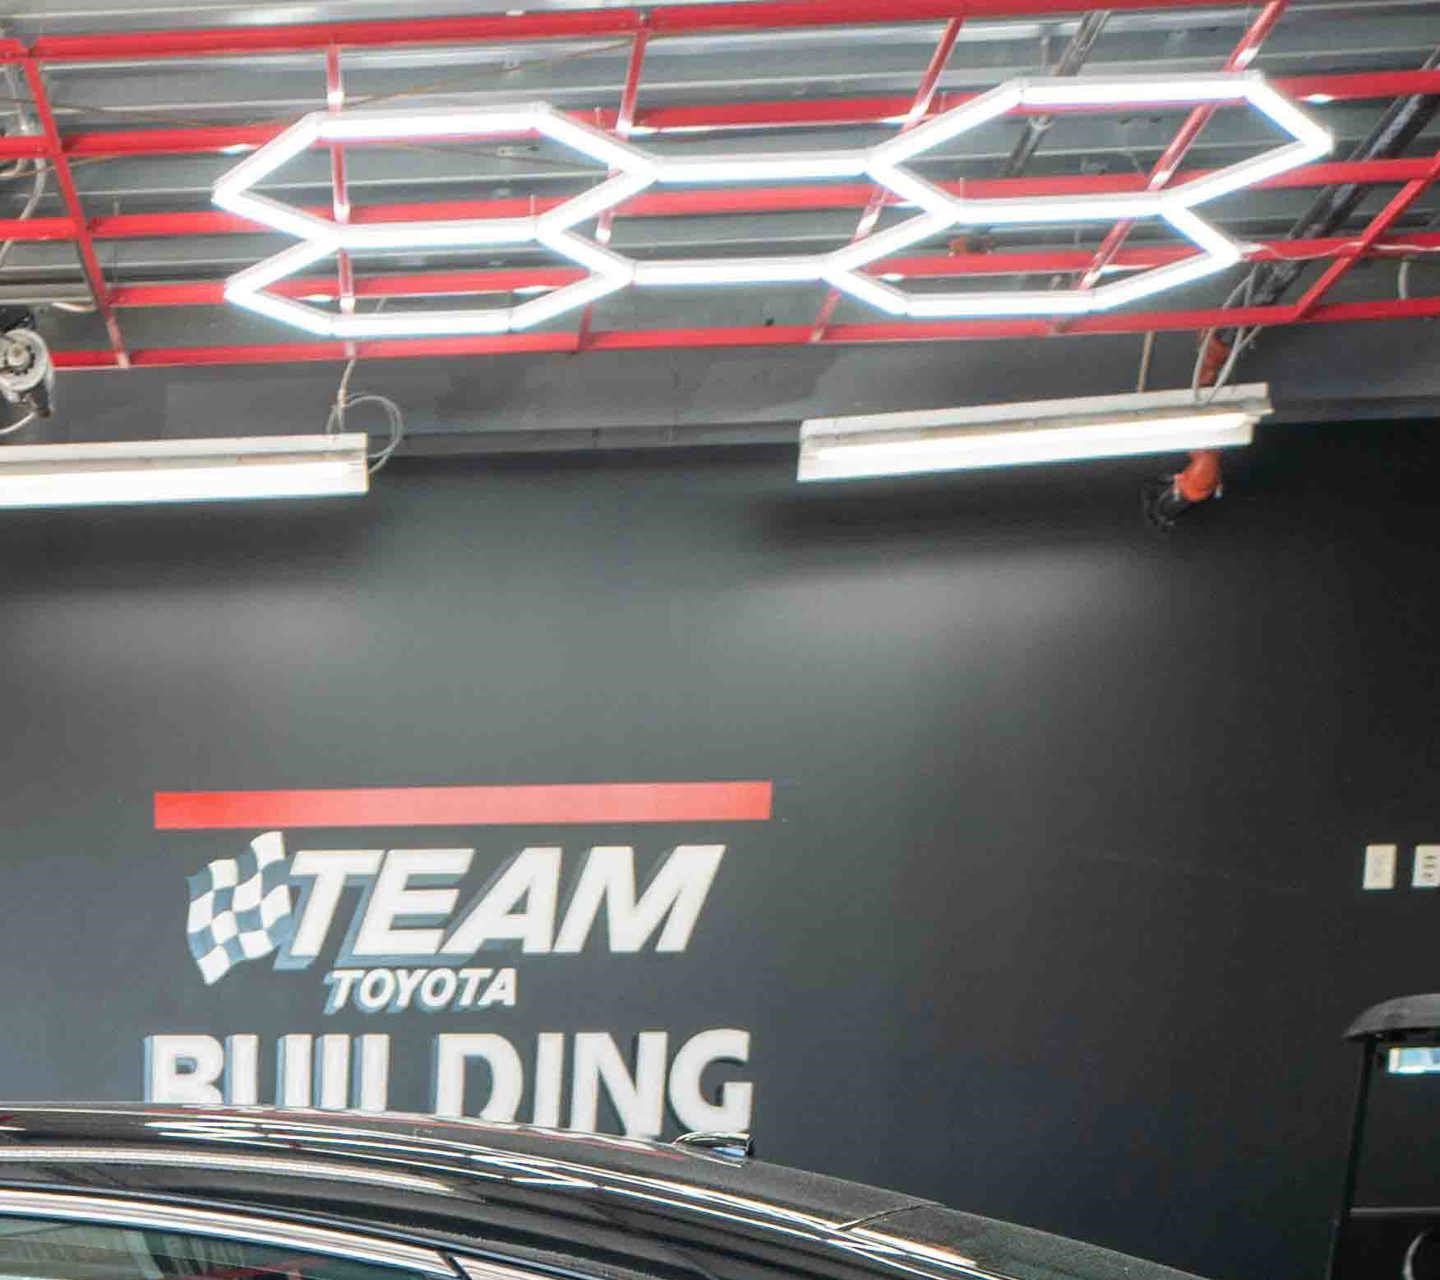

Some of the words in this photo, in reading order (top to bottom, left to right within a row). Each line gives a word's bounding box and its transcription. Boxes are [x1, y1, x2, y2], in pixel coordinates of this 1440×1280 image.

[280, 844, 727, 960] TEAM
[324, 967, 517, 1012] TOYOTA
[147, 1029, 754, 1137] BUILDING
